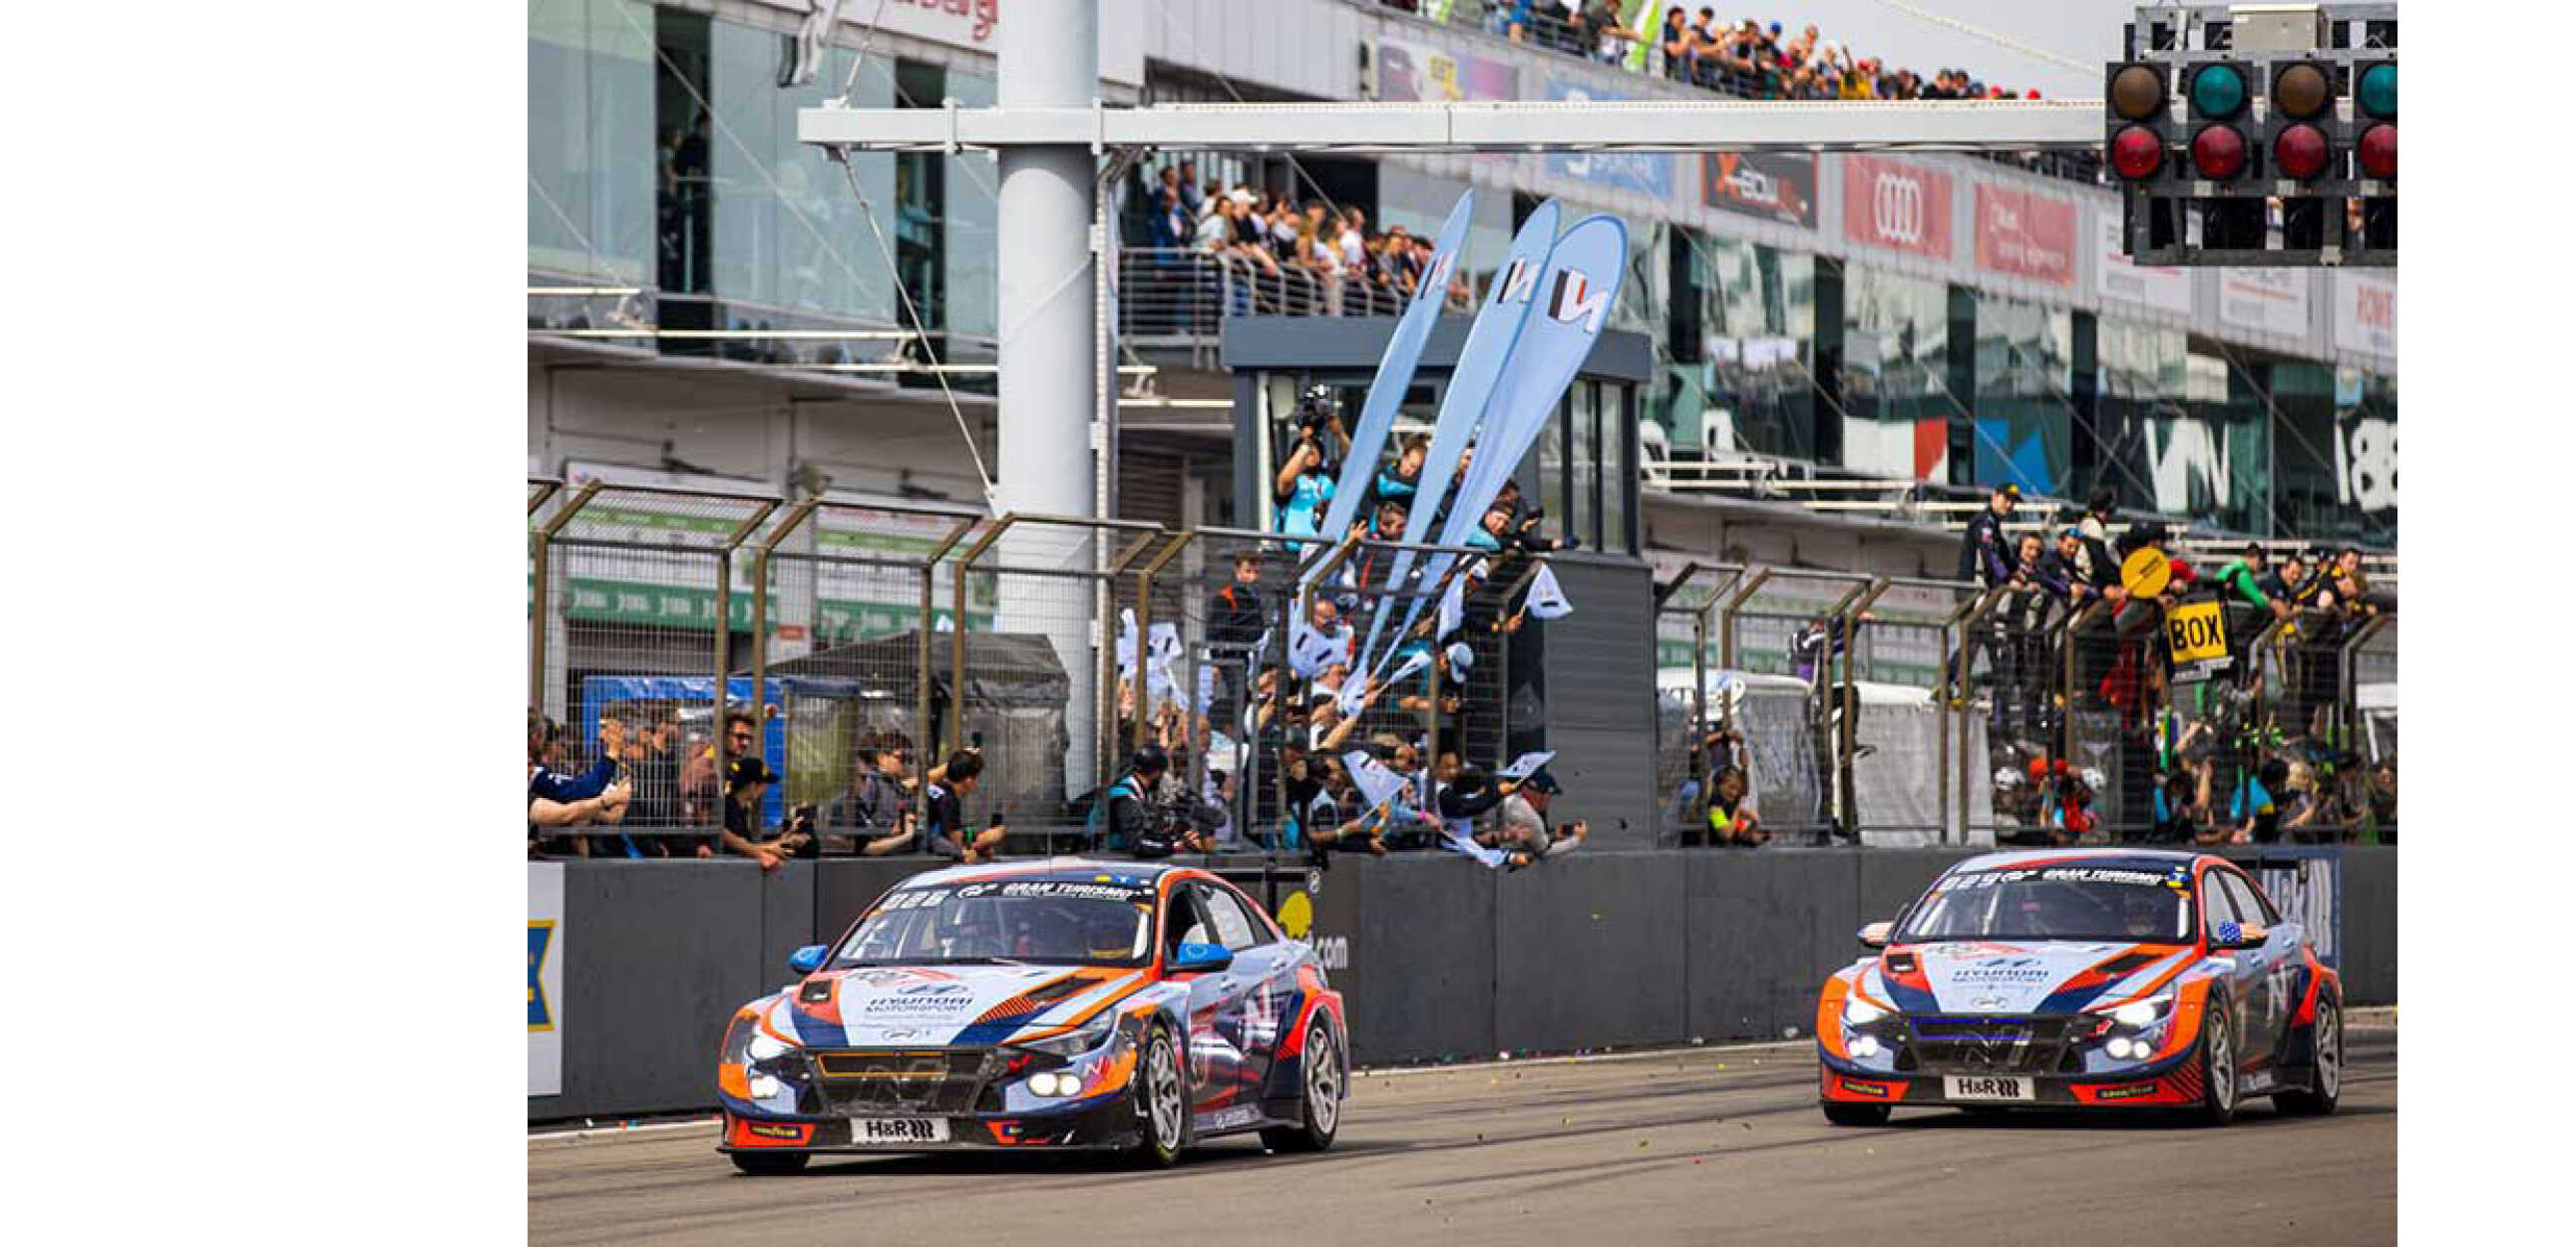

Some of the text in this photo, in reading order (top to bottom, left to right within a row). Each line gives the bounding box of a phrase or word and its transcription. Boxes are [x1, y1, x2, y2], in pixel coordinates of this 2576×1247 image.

[2169, 615, 2222, 650] BOX
[1958, 1077, 1999, 1096] H&R
[866, 1119, 909, 1138] H&R
